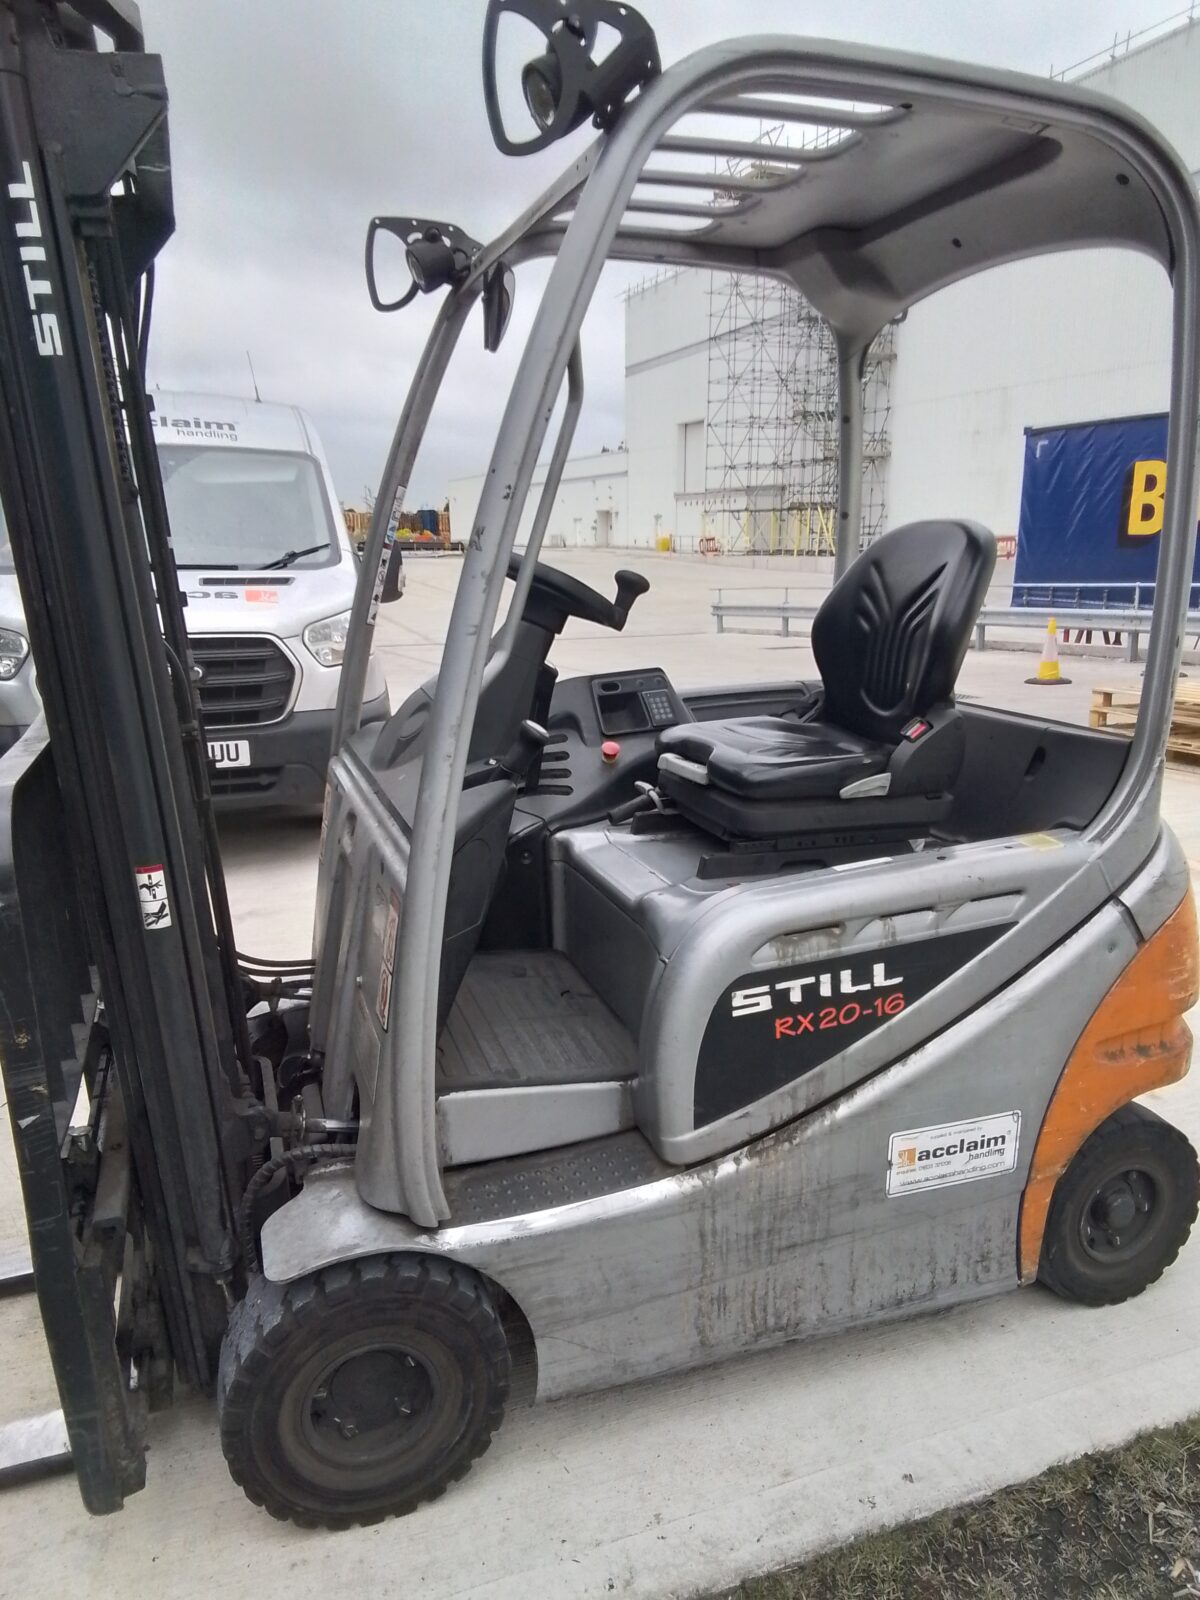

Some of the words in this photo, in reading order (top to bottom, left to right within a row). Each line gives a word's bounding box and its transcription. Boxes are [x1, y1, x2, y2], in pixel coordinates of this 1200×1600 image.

[7, 160, 64, 357] STILL
[176, 428, 238, 442] handling
[731, 962, 904, 1018] STILL
[917, 1134, 1007, 1162] acclaim
[968, 1147, 1006, 1161] handling
